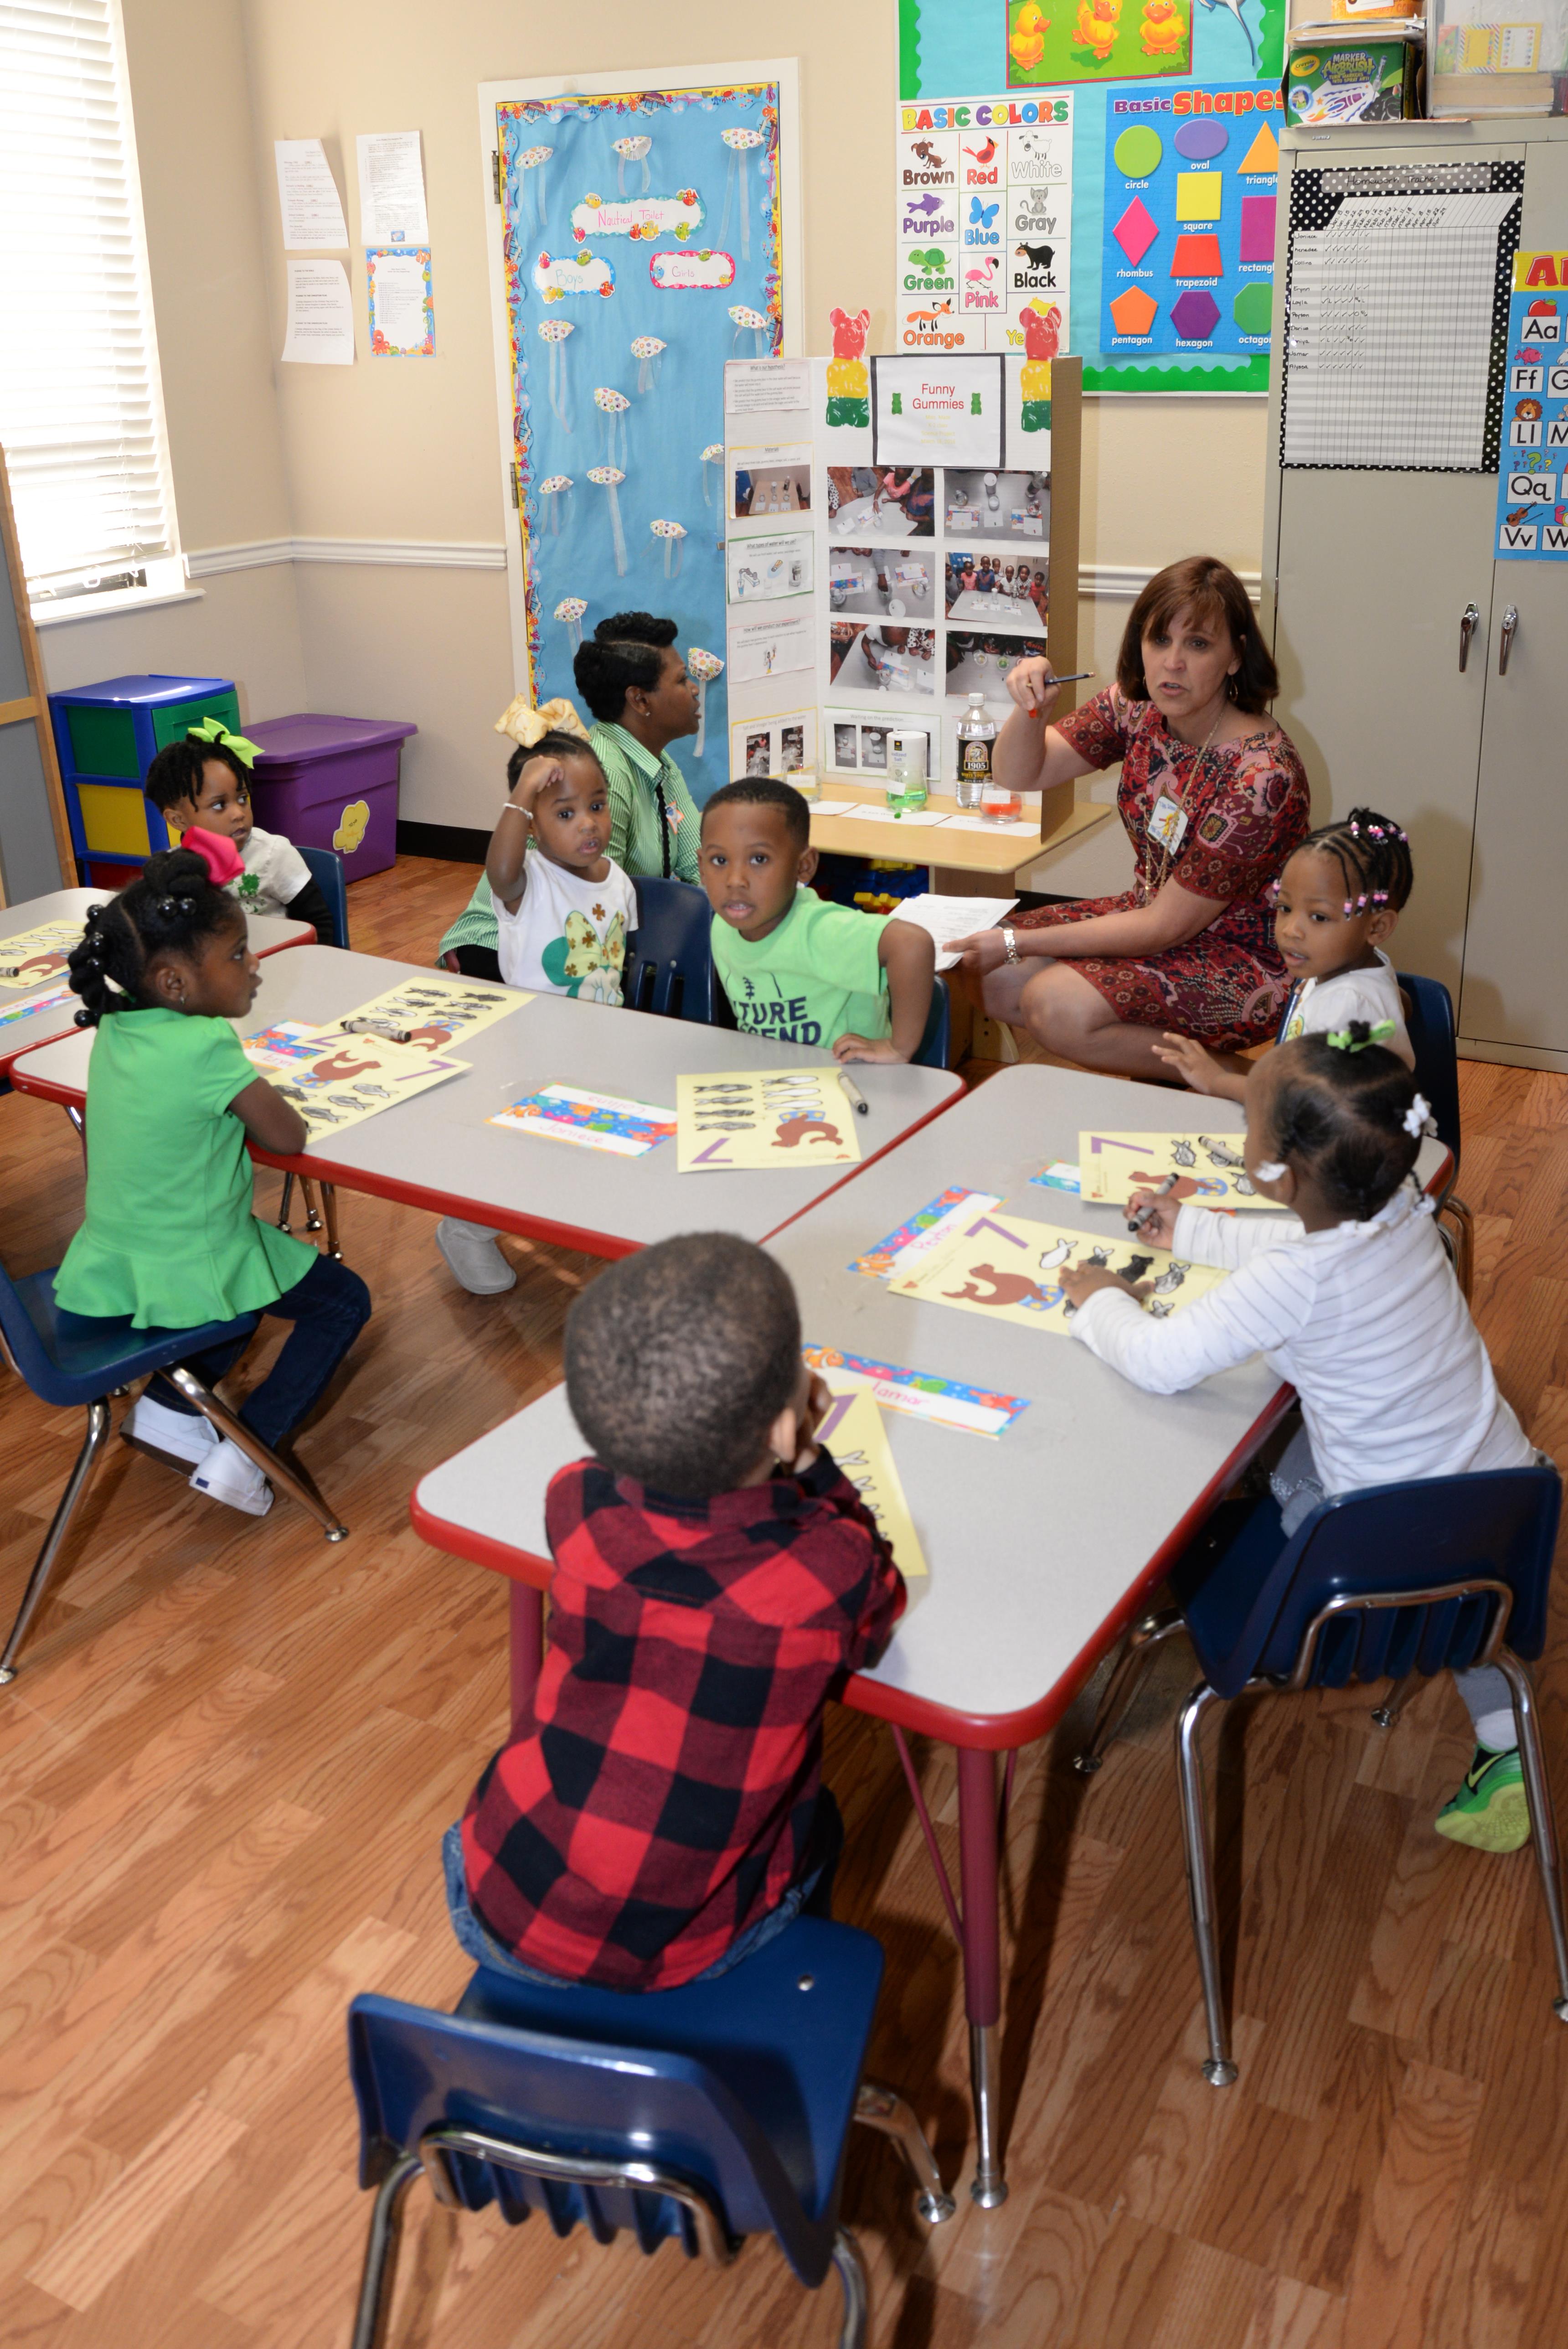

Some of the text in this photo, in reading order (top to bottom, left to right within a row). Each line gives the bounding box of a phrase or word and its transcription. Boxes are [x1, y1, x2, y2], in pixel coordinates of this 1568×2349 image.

[1295, 59, 1315, 68] Crayola
[1333, 52, 1366, 62] MARKER
[1114, 97, 1171, 113] Basic
[902, 101, 1068, 131] BASIC COLORS
[1011, 160, 1062, 178] White
[1191, 160, 1210, 170] oval
[903, 168, 954, 186] Brown
[967, 166, 998, 185] Red
[1346, 176, 1399, 186] Homework
[1125, 180, 1149, 189] circle
[598, 209, 665, 227] Nautical Toilet
[903, 216, 954, 237] Purple
[1015, 215, 1057, 235] Gray
[1183, 222, 1213, 233] square
[965, 228, 1000, 246] Blue
[671, 266, 695, 278] Girls
[1117, 269, 1154, 278] rhombus
[1238, 262, 1274, 274] rectangl
[1525, 255, 1568, 286] A
[555, 269, 584, 290] Boys
[903, 274, 954, 290] Green
[1014, 271, 1057, 288] Black
[1176, 277, 1218, 289] trapezoid
[965, 290, 999, 308] Pink
[1524, 319, 1558, 339] Aa
[903, 330, 965, 349] Orange
[1112, 336, 1153, 347] pentagon
[1176, 338, 1213, 349] hexagon
[1516, 369, 1538, 389] Ff
[922, 383, 955, 398] Funny
[913, 398, 965, 409] Gummies
[1516, 424, 1535, 444] Ll
[1511, 476, 1552, 501] Qq
[1504, 528, 1533, 547] Vv
